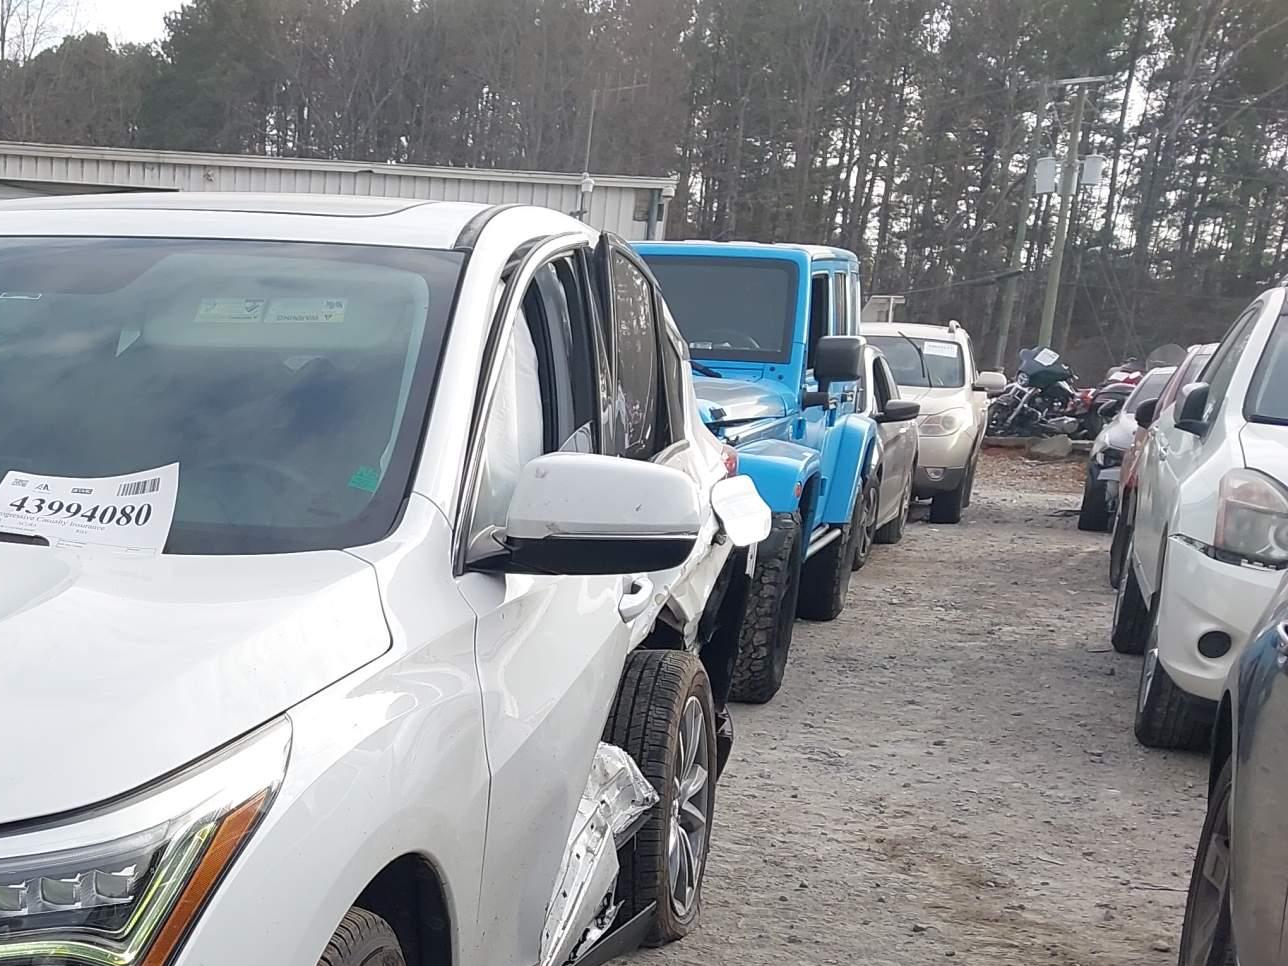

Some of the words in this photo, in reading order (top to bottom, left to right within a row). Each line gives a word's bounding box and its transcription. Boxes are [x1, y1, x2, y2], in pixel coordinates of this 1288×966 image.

[9, 495, 152, 527] 43994080
[36, 516, 66, 527] Casualty
[69, 521, 106, 531] Insurance
